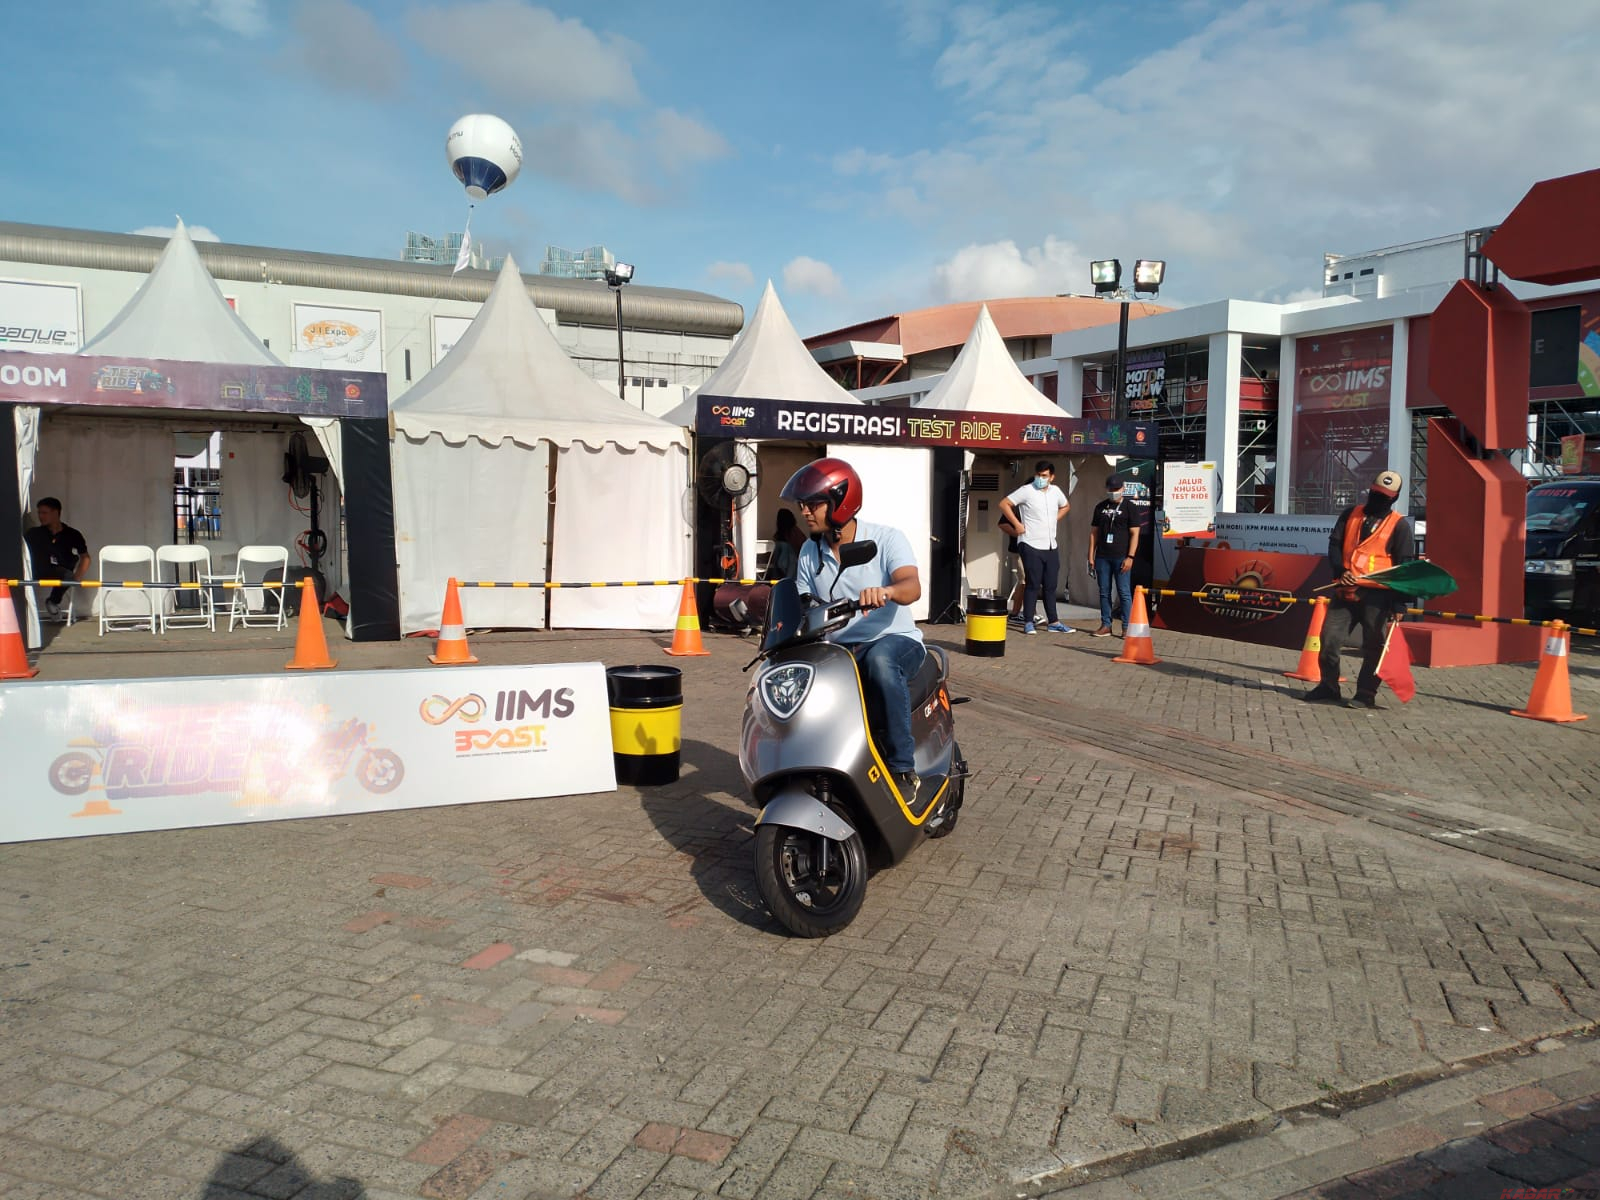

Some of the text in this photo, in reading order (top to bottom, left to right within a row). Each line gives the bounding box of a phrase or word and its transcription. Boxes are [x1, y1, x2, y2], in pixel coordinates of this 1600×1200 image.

[1125, 367, 1165, 384] MOTOR
[1344, 366, 1388, 391] IIMS
[1125, 381, 1163, 399] SHOW
[731, 406, 755, 418] IIMS
[777, 409, 1002, 441] REGISTRASI TEST RIDE
[495, 687, 575, 722] IIMS
[104, 743, 246, 797] RIDE
